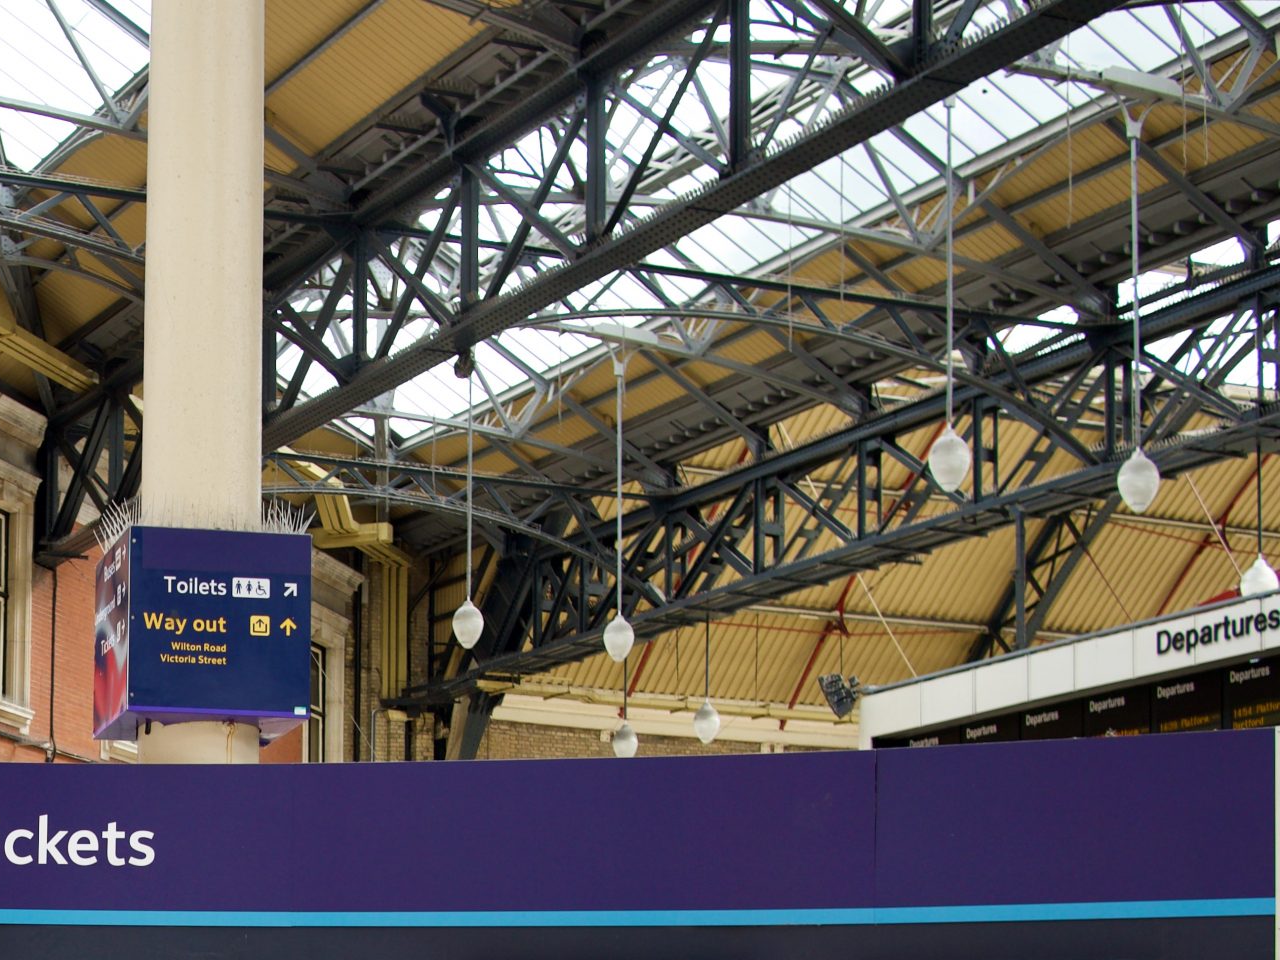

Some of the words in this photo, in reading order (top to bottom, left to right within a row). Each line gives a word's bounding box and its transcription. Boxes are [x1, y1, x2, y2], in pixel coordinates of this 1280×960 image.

[163, 576, 227, 596] Toilets
[143, 612, 187, 635] Way
[193, 617, 227, 633] out
[1156, 609, 1280, 655] Departures
[171, 641, 201, 651] Wilton
[203, 643, 227, 653] Road
[160, 653, 196, 664] Victoria
[198, 655, 227, 665] Street
[1229, 666, 1270, 684] Departures
[1157, 682, 1195, 699] Departures
[1089, 696, 1126, 713] Departures
[1025, 711, 1059, 727] Departures
[966, 724, 998, 740] Departures
